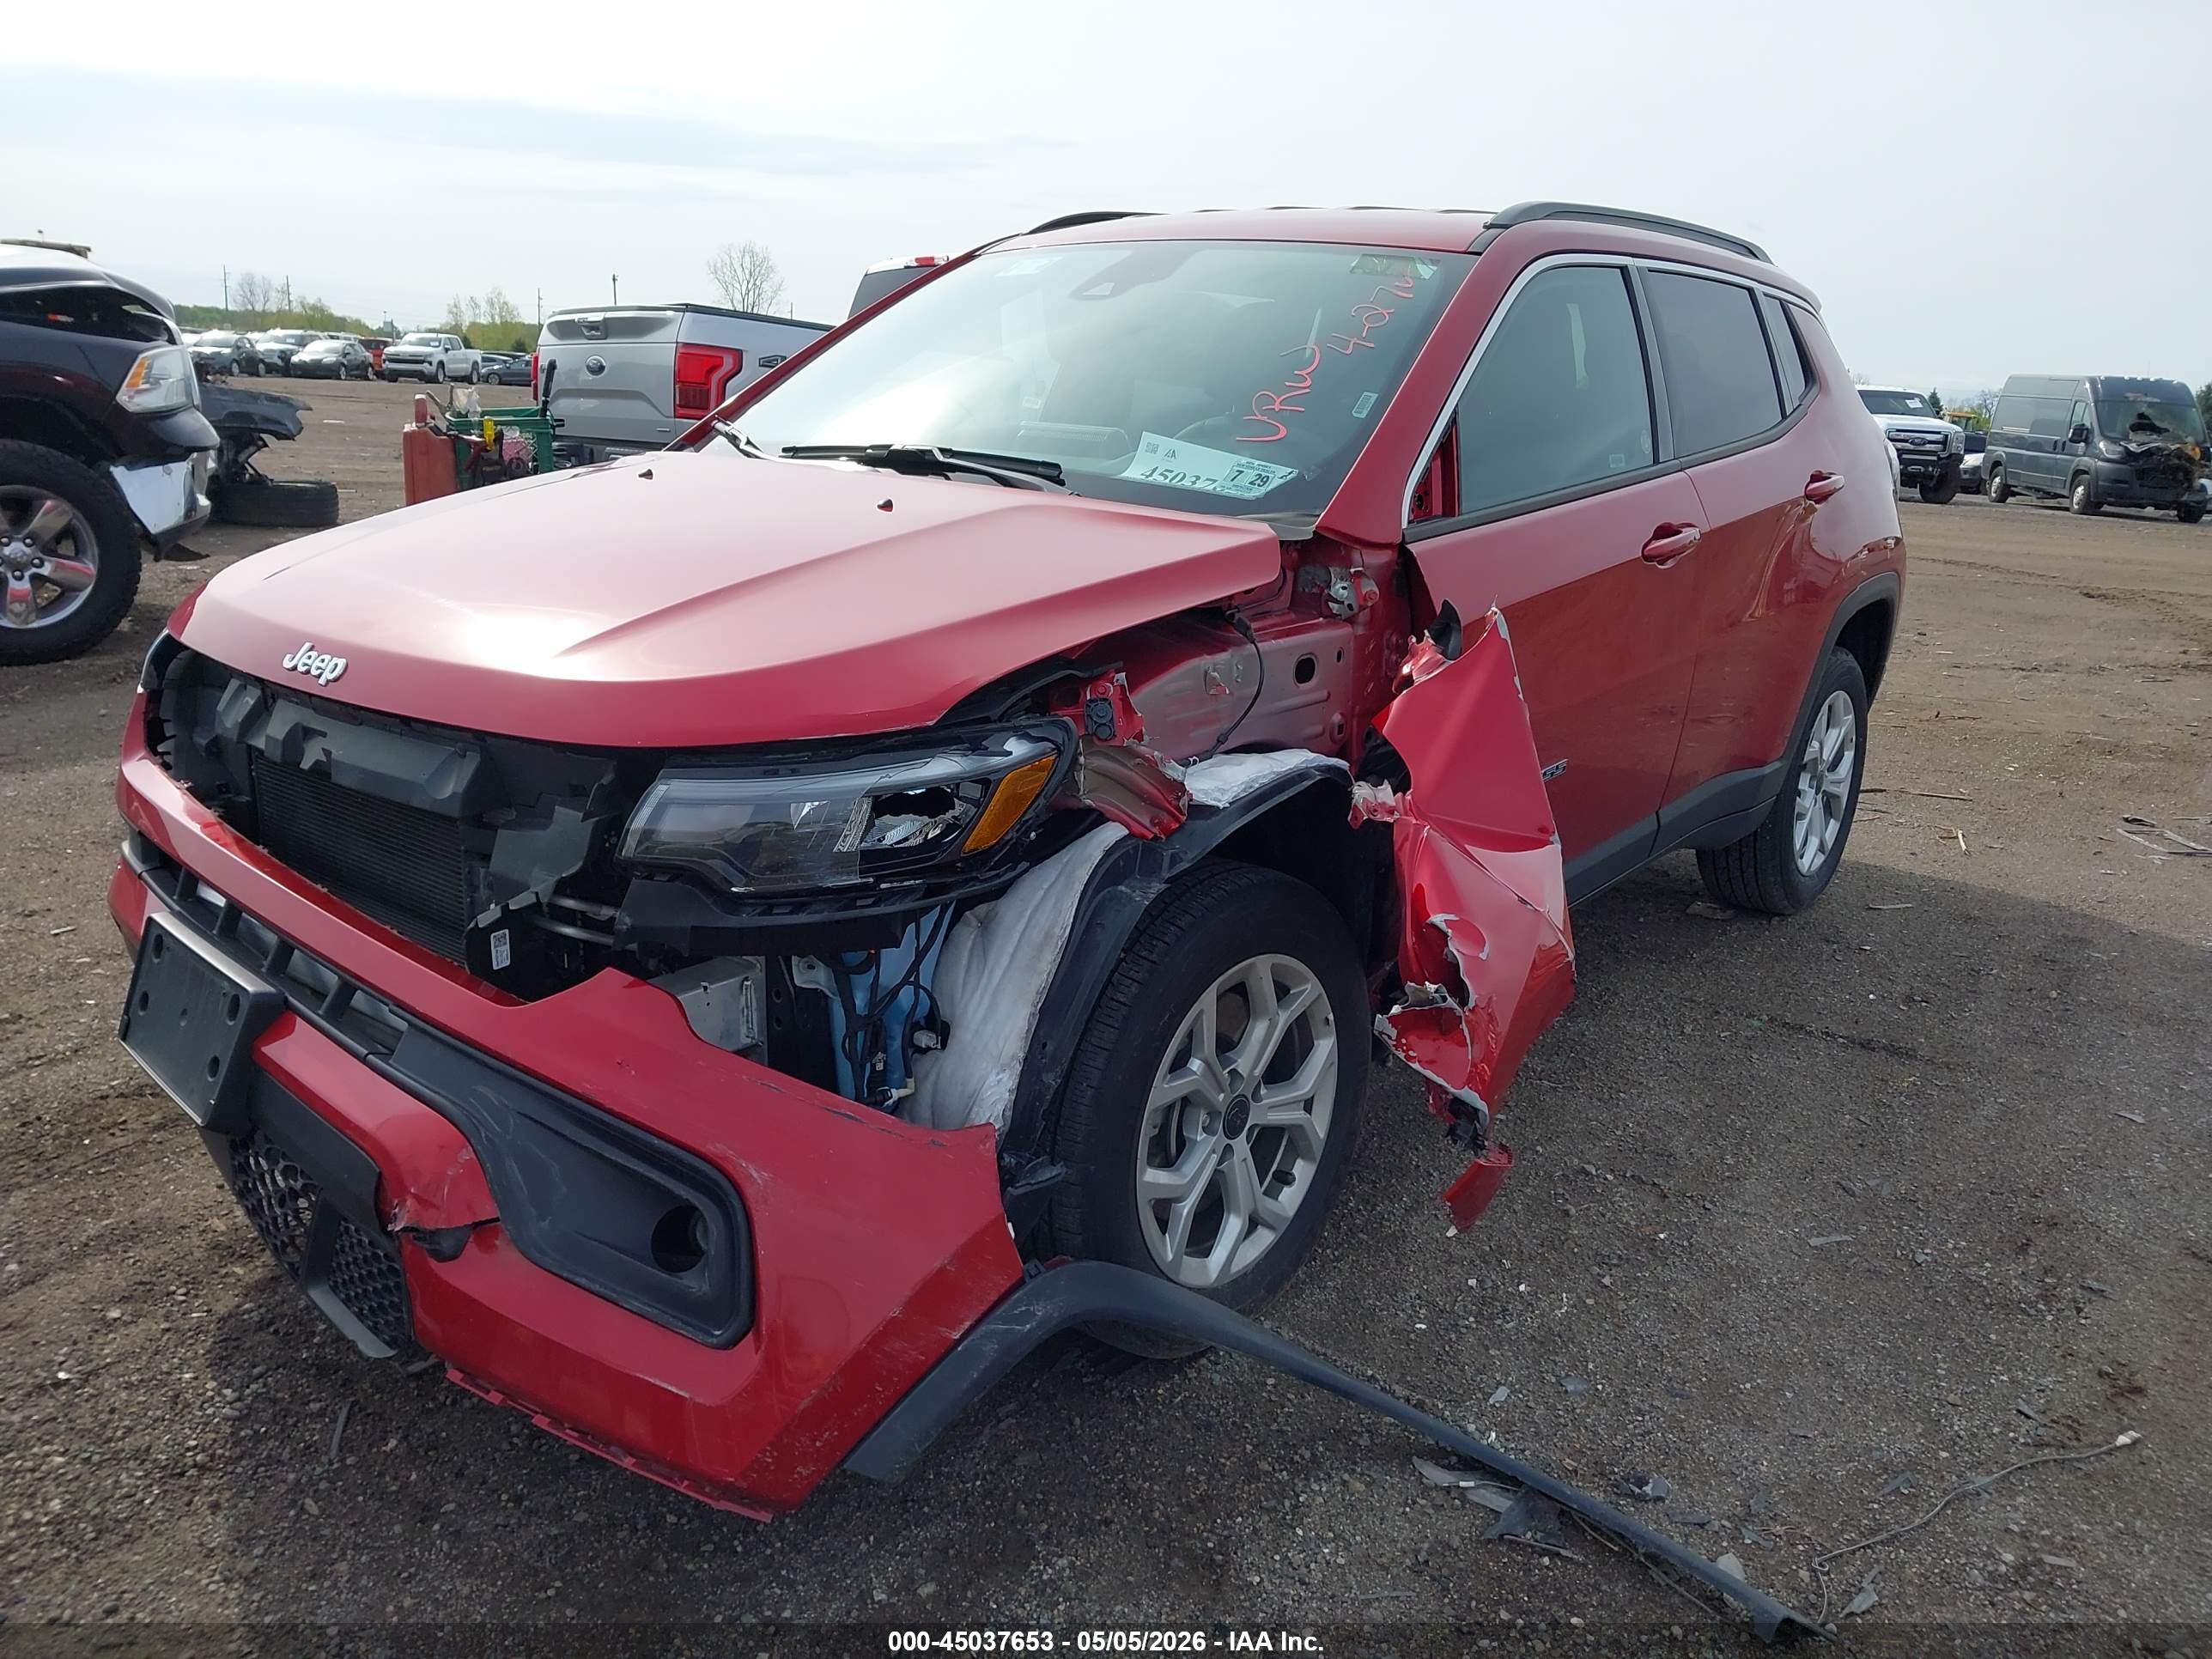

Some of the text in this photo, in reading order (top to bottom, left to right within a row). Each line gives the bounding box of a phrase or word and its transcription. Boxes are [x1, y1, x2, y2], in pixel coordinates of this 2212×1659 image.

[1140, 465, 1219, 492] 45037
[1231, 470, 1244, 482] 7
[1248, 473, 1270, 488] 29
[283, 641, 348, 687] Jeep
